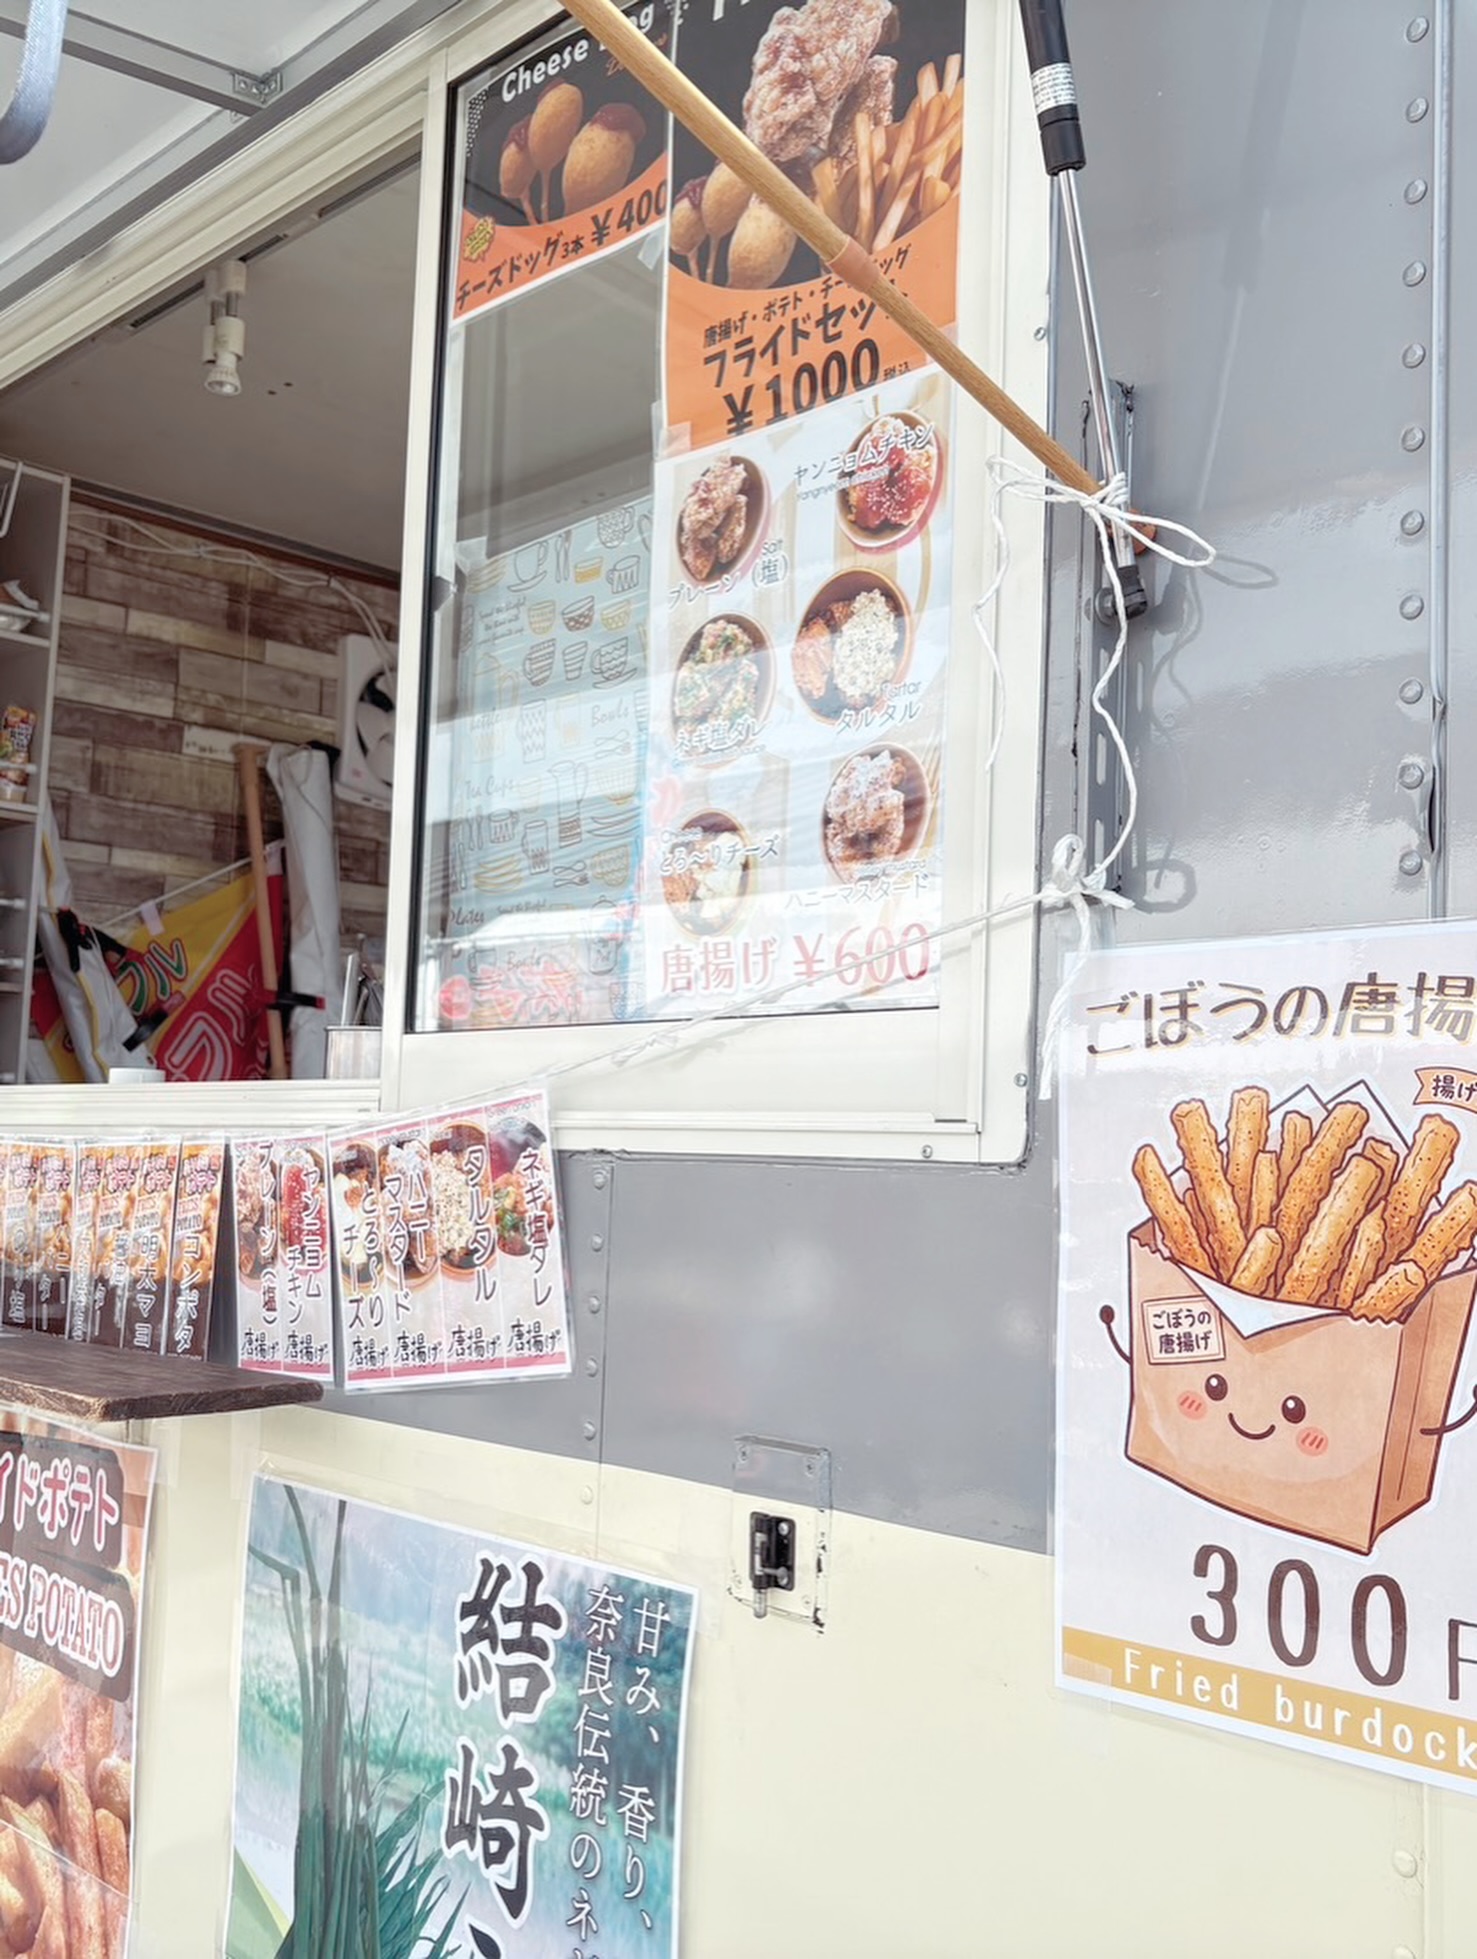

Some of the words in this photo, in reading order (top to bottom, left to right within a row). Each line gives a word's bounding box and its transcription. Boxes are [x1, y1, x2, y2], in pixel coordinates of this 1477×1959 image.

[502, 39, 590, 103] Cheese
[703, 279, 908, 388] フライドセッ
[723, 338, 880, 435] ¥1000
[836, 700, 921, 735] タルタル
[784, 874, 929, 910] ハニーマスタード
[662, 937, 777, 993] 唐揚げ
[793, 922, 930, 987] ¥600
[1086, 971, 1475, 1055] ごぼうの唐揚
[303, 1168, 322, 1298] ヤンニョム
[385, 1177, 411, 1321] マスタード
[408, 1170, 430, 1261] ハニー
[464, 1146, 497, 1302] タルタル
[174, 1235, 202, 1352] コンポタ
[287, 1246, 303, 1324] チキン
[343, 1223, 365, 1329] チーズ
[241, 1328, 279, 1358] 唐揚げ
[285, 1331, 328, 1362] 唐揚げ
[350, 1336, 388, 1367] 唐揚げ
[394, 1331, 441, 1363] 唐揚げ
[447, 1325, 500, 1359] 唐揚げ
[507, 1318, 561, 1354] 唐揚げ
[1153, 1308, 1212, 1329] ごぼうの
[1159, 1330, 1212, 1354] 唐揚げ
[25, 1563, 124, 1677] POTATO
[1124, 1648, 1238, 1710] Fried
[1276, 1684, 1477, 1769] burdock
[445, 1553, 564, 1959] 結崎
